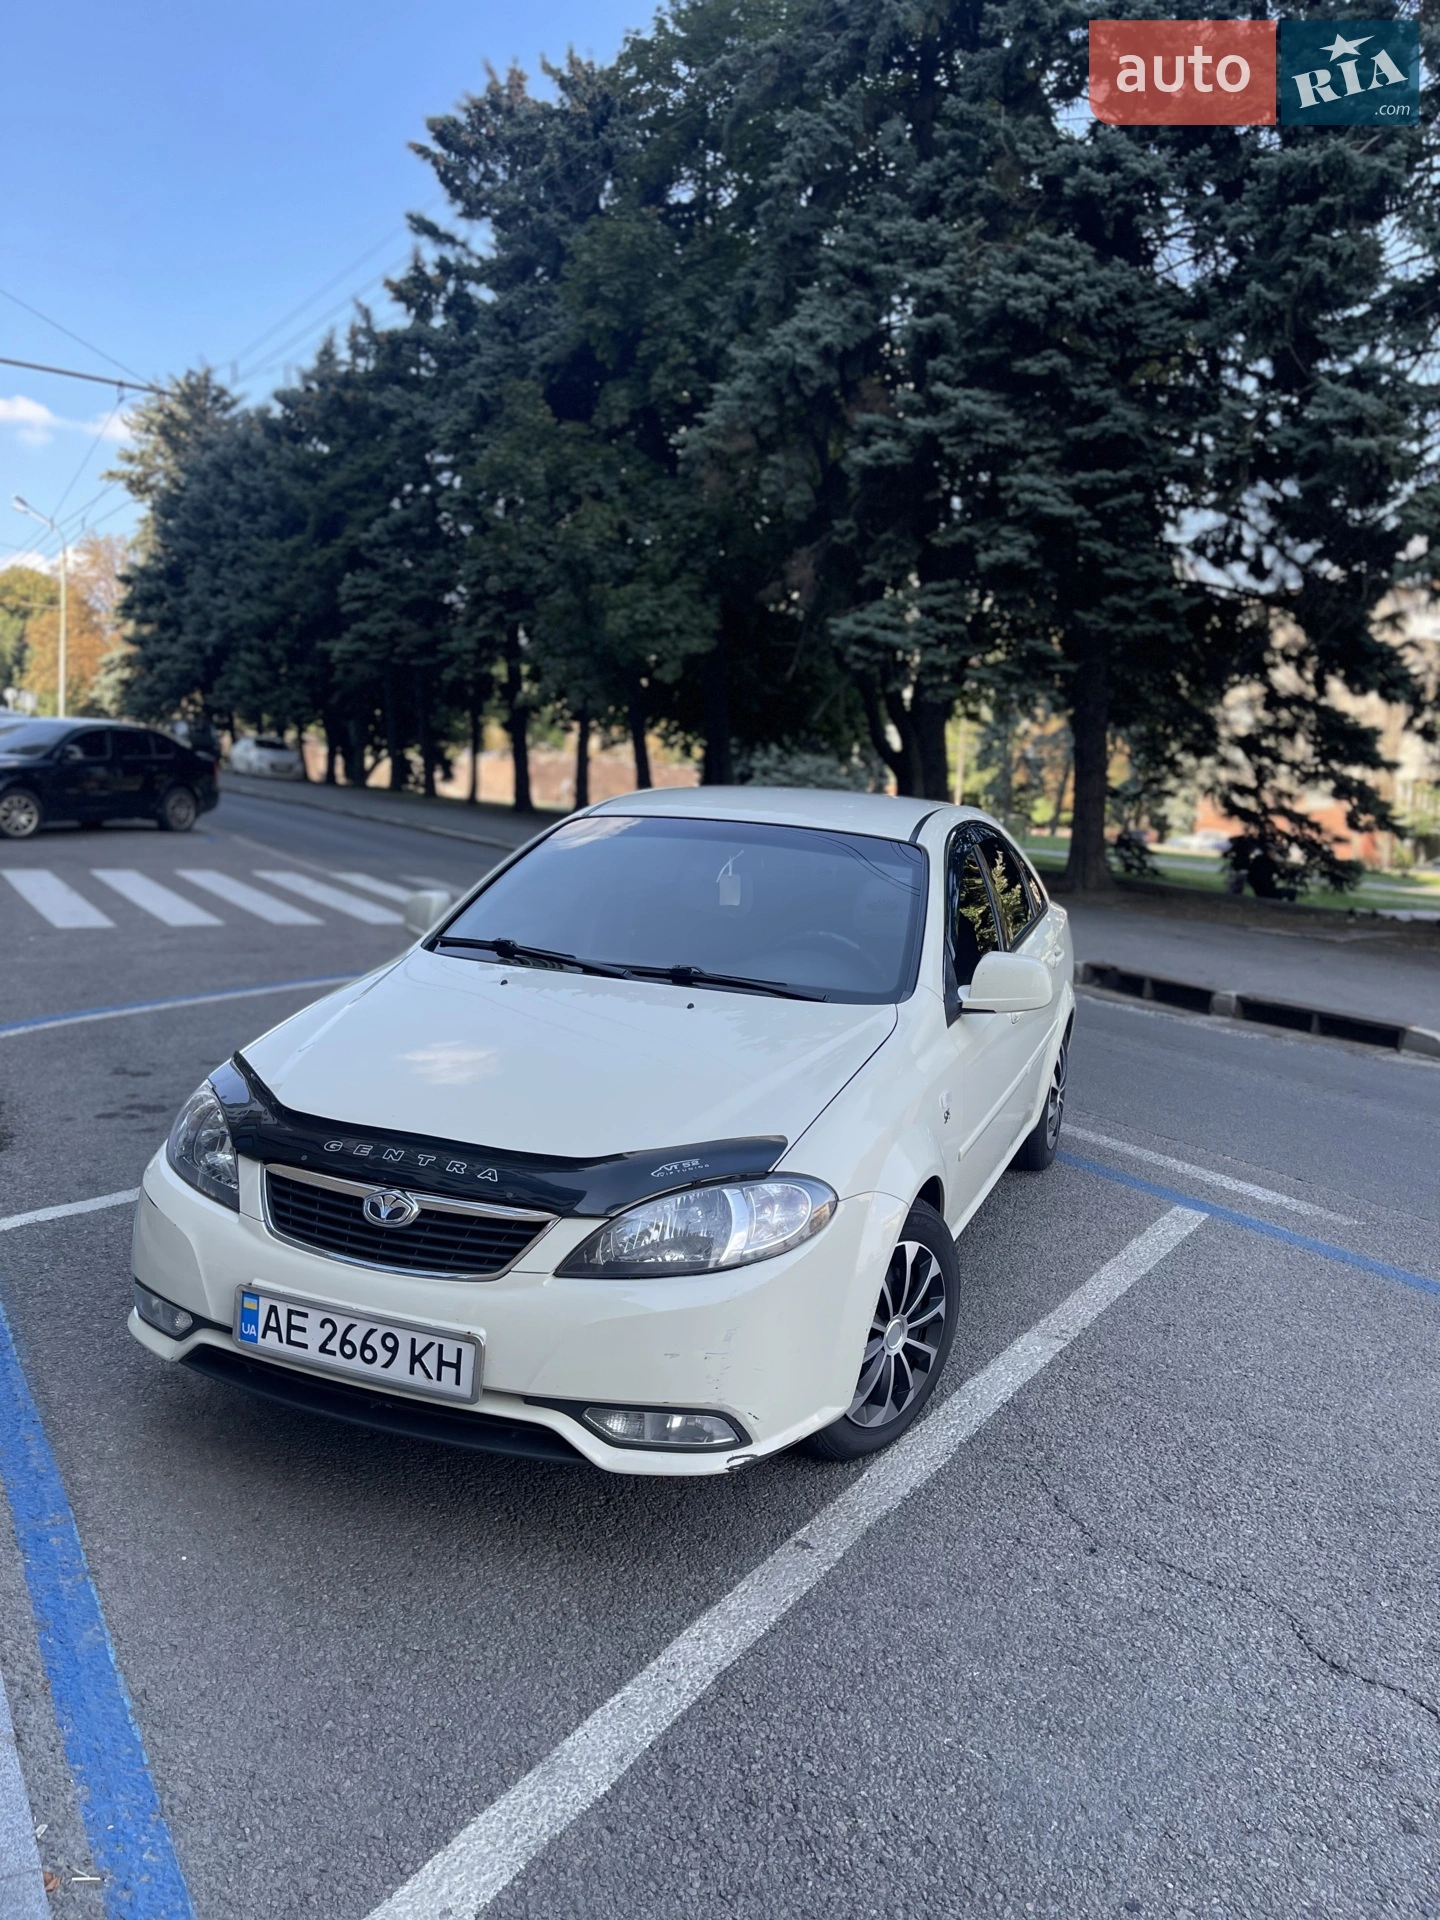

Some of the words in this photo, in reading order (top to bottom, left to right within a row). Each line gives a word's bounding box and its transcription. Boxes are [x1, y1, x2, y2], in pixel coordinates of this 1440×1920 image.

[323, 1140, 498, 1182] GENTRA
[241, 1322, 257, 1337] UA
[261, 1304, 309, 1350] AE
[318, 1318, 400, 1369] 2669
[409, 1337, 463, 1386] KH
